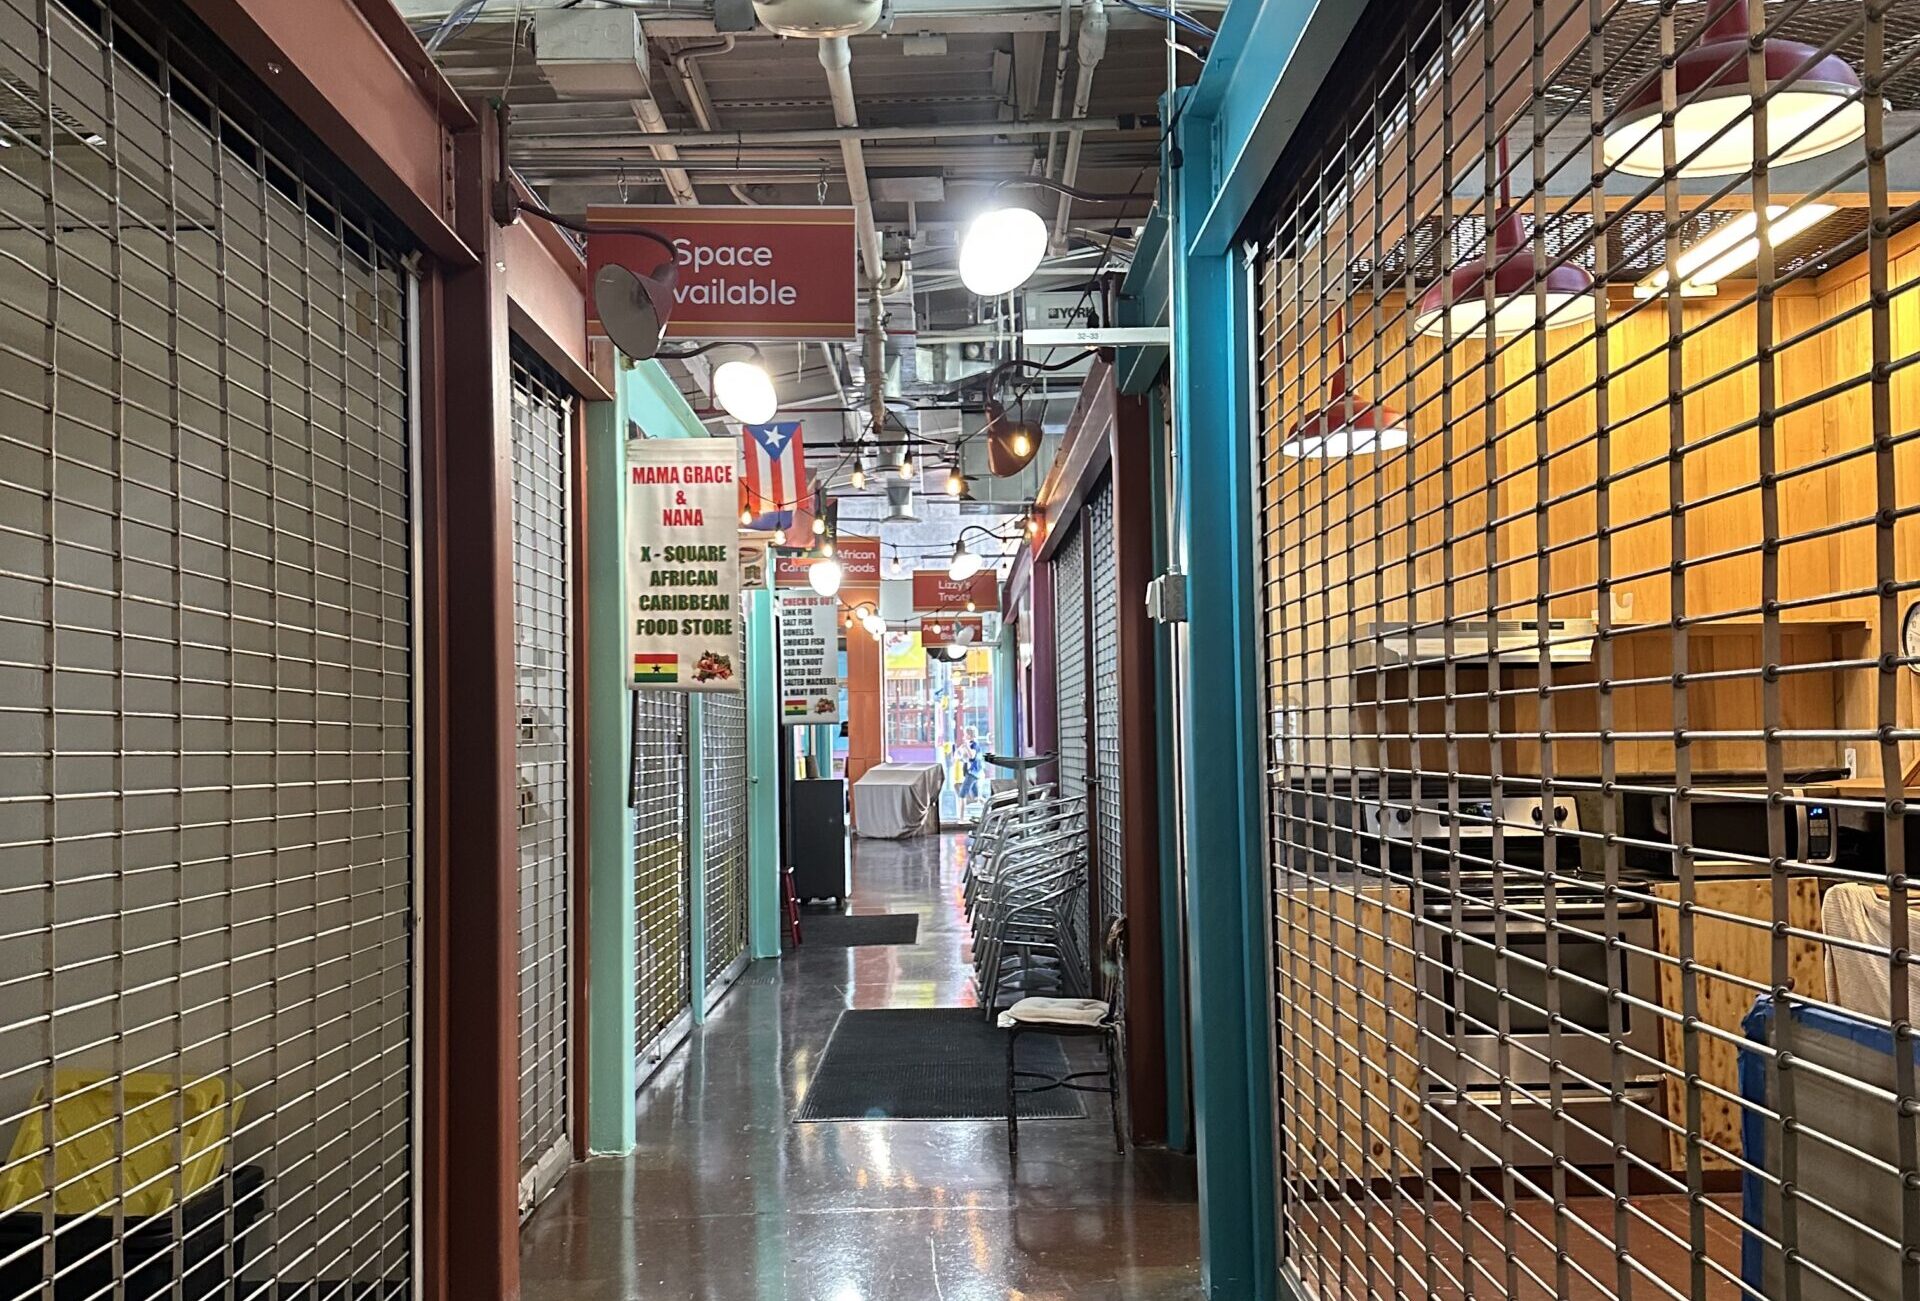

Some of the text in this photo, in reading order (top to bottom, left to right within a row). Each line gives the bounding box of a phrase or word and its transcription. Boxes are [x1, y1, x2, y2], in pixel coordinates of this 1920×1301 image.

[672, 238, 773, 273] Space
[672, 278, 798, 306] vailable
[1077, 332, 1099, 340] 32-33
[632, 465, 733, 485] MAMA GRACE
[675, 490, 687, 505] &
[662, 508, 704, 527] NANA
[640, 546, 651, 562] X
[664, 545, 727, 563] SQUARE
[837, 549, 876, 560] African
[842, 563, 876, 573] Foods
[649, 570, 718, 587] AFRICAN
[937, 580, 971, 592] Lizzy's
[782, 596, 835, 607] CHECK US OUT
[937, 592, 971, 602] Treats
[638, 594, 730, 612] CARIBBEAN
[797, 608, 812, 616] FISH
[636, 618, 733, 636] FOOD STORE
[782, 618, 813, 627] SALT FISH
[783, 628, 814, 637] BONELESS
[783, 638, 825, 647] SMOKED FISH
[783, 649, 795, 657] RED
[784, 658, 823, 667] PORK SNOUT
[784, 668, 822, 677] SALTED BEEF
[784, 678, 804, 687] SALTED
[790, 688, 808, 696] MANY
[809, 687, 828, 696] MORE
